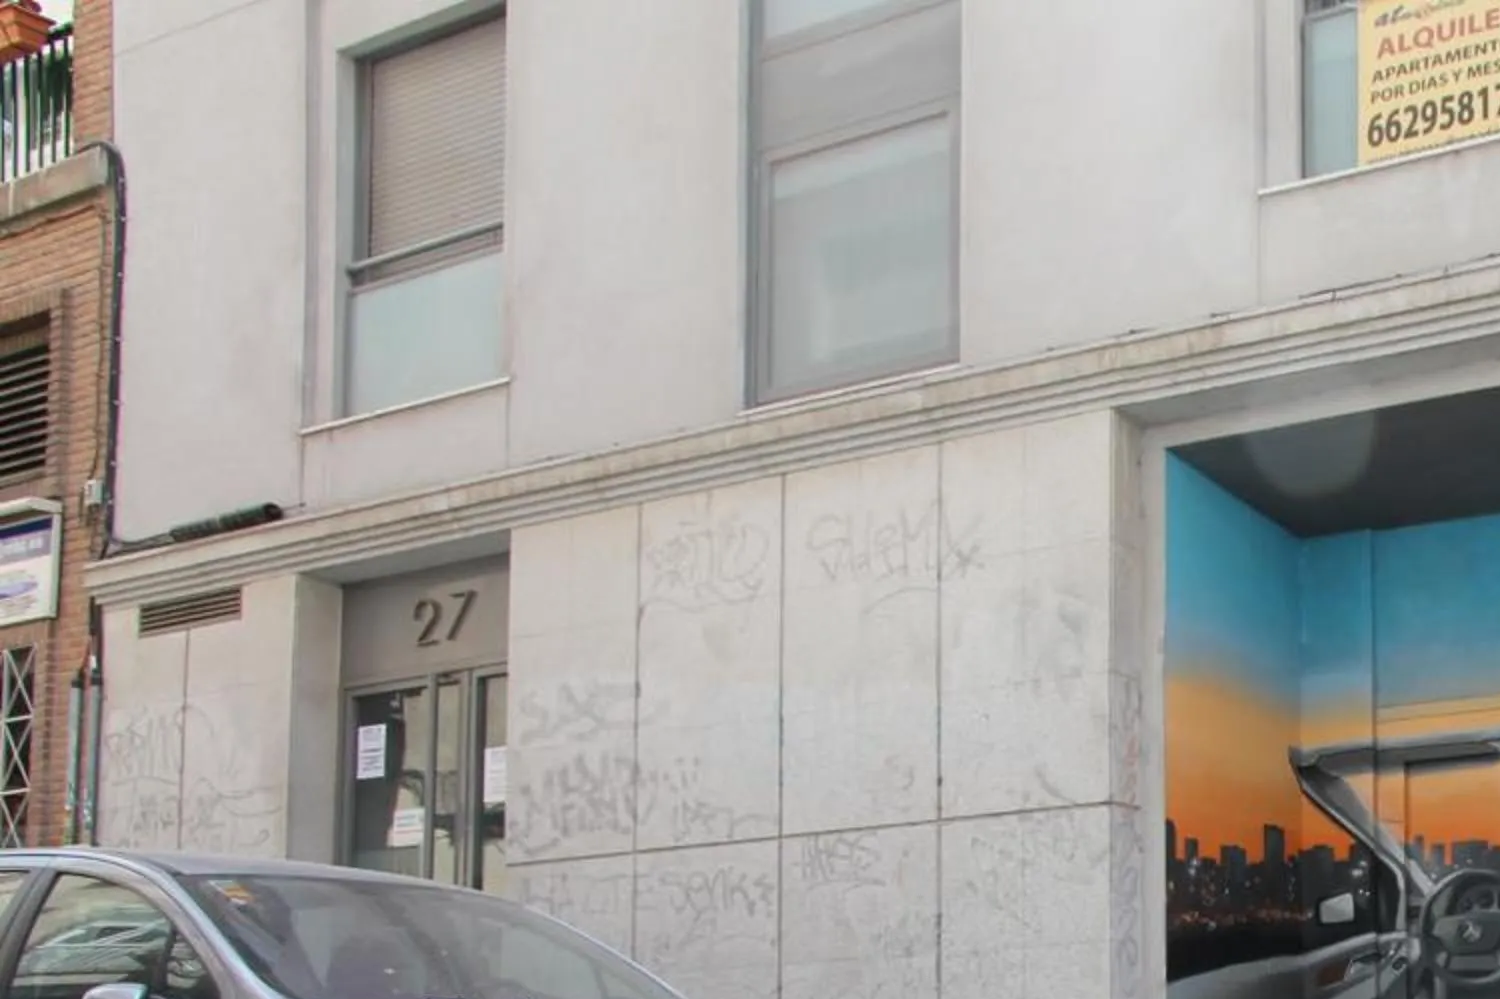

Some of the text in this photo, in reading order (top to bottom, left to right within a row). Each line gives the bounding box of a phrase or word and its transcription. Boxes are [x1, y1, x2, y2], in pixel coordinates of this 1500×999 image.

[1370, 83, 1405, 104] POR
[1408, 72, 1449, 95] DIAS
[1452, 68, 1463, 83] Y
[412, 589, 478, 648] 27
